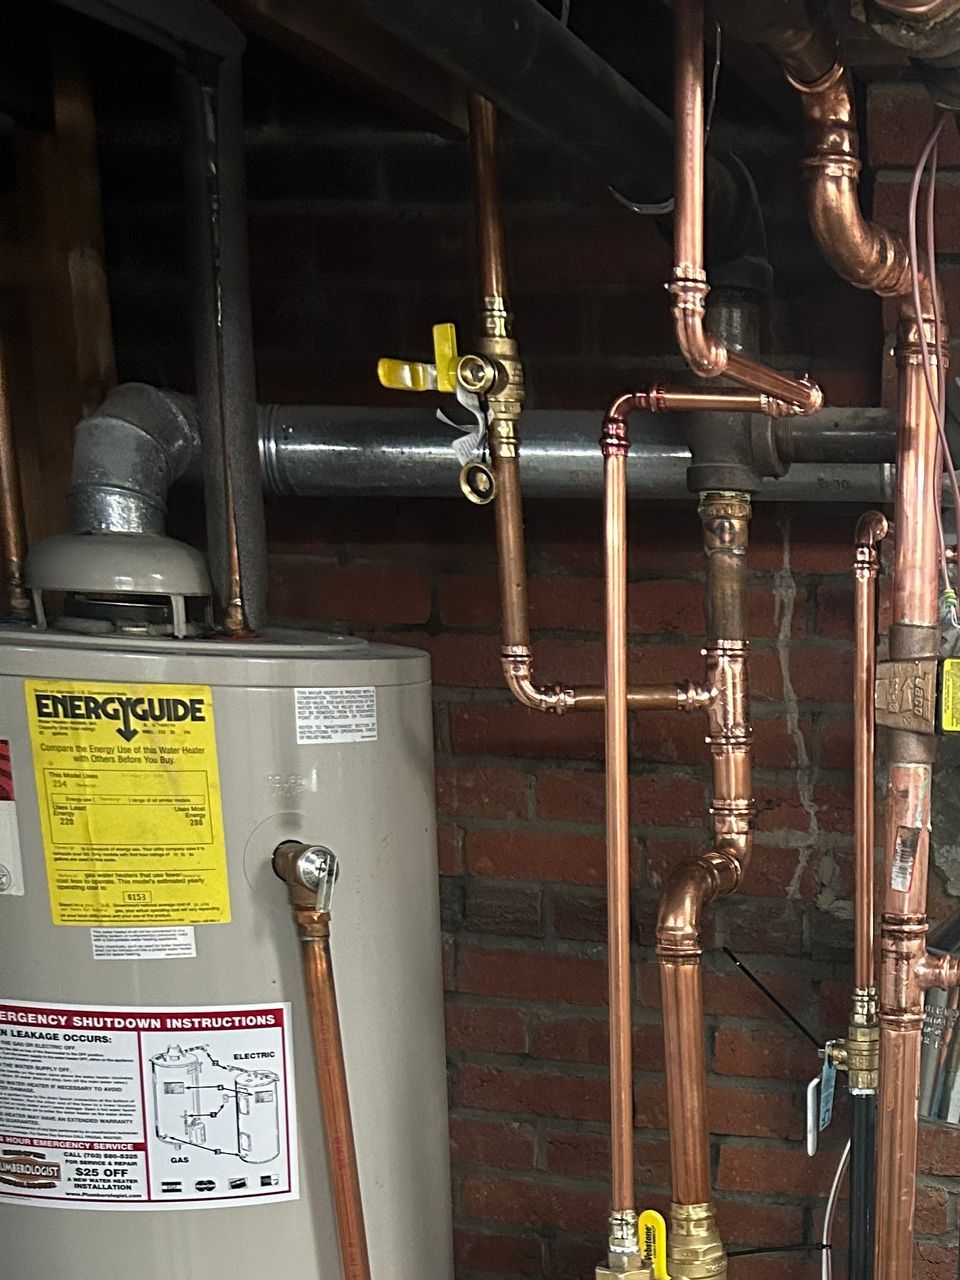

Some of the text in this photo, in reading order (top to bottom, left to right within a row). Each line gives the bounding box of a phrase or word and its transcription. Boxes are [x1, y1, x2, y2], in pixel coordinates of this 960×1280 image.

[35, 694, 206, 724] ENERGYGUIDE
[40, 743, 205, 755] Compare the Energy Use of this Water Heater
[73, 754, 90, 762] with
[90, 755, 116, 764] Others
[117, 756, 142, 764] Before
[143, 756, 159, 764] You
[0, 1011, 275, 1029] ERGENCY SHUTDOWN INSTRUCTIONS
[11, 1030, 60, 1041] LEAKAGE
[63, 1034, 112, 1043] OCCURS:
[234, 1052, 275, 1060] ELECTRIC
[6, 1137, 31, 1146] HOUR
[33, 1139, 90, 1149] EMERGENCY
[103, 1168, 128, 1178] OFF
